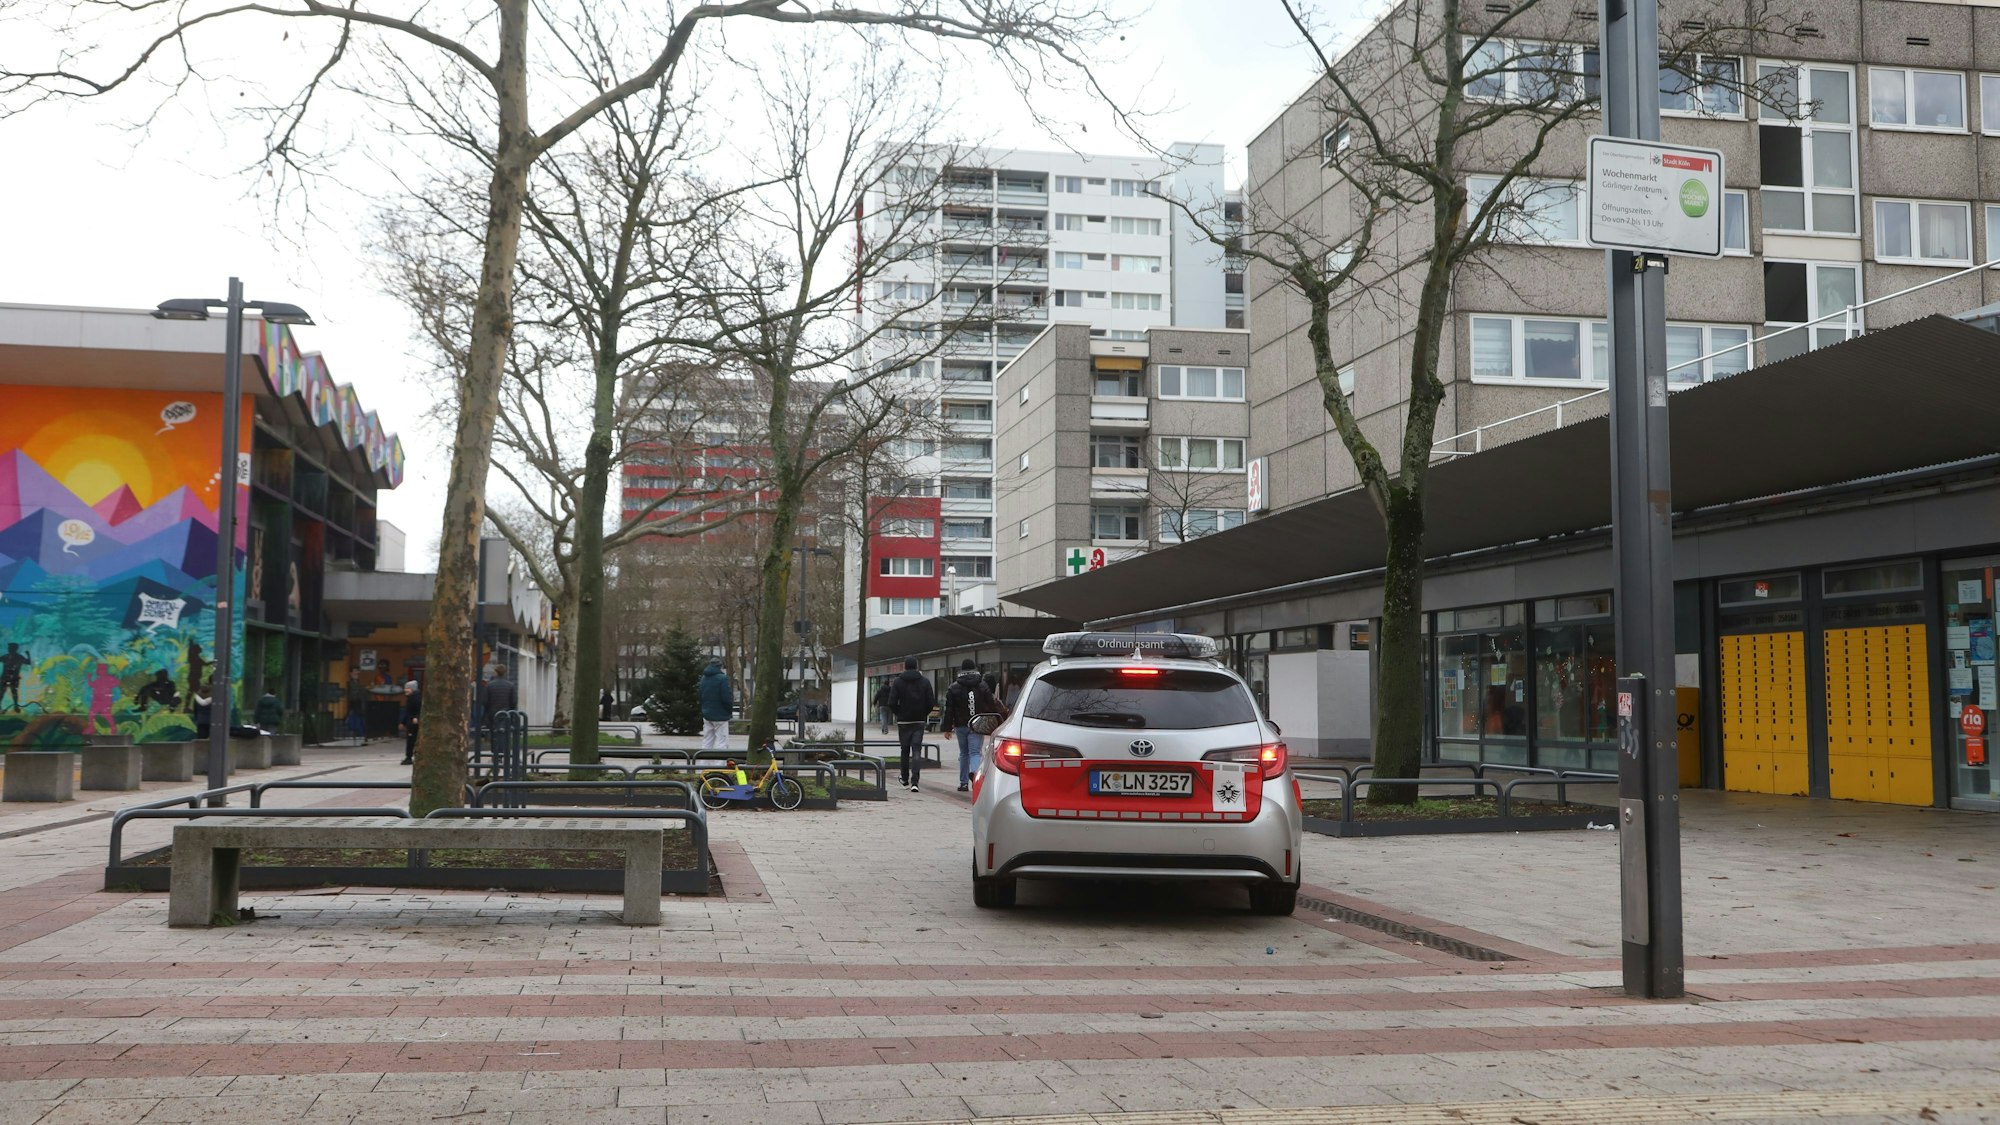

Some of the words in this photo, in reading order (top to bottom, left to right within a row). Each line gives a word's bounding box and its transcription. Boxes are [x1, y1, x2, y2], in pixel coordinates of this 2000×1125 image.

[1663, 157, 1677, 165] Stadt
[1602, 168, 1658, 182] Wochenmarkt
[1602, 180, 1632, 192] Görlinger
[1634, 184, 1662, 194] Zentrum
[1601, 201, 1653, 215] Öffnungszeiten:
[1631, 218, 1641, 226] bis
[1652, 219, 1664, 228] Uhr
[1097, 638, 1165, 650] Ordnungsamt
[1963, 708, 1982, 726] ria
[1101, 774, 1111, 789] K
[1123, 774, 1145, 790] LN
[1148, 775, 1190, 791] 3257
